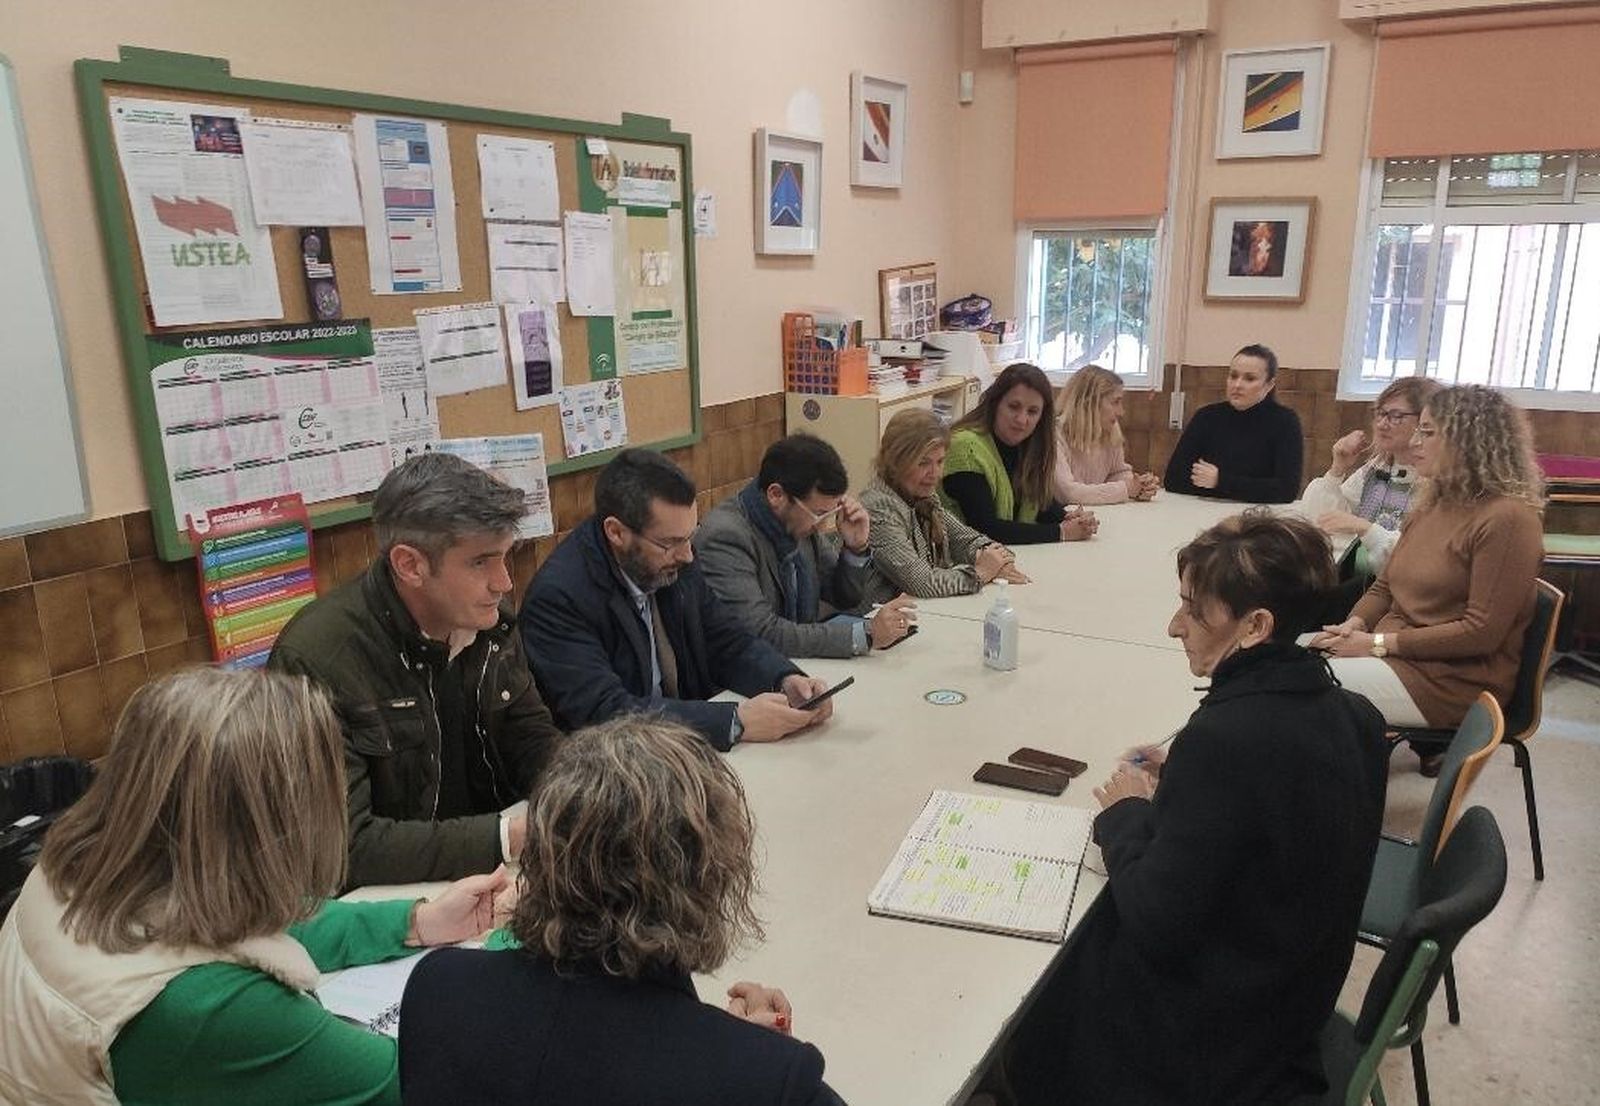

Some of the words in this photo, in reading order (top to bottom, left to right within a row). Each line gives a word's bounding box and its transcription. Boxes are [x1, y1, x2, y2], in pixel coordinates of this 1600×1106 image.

[171, 242, 251, 267] USTEA
[183, 332, 259, 350] CALENDARIO
[260, 328, 310, 343] ESCOLAR
[311, 325, 358, 338] 2022-2023
